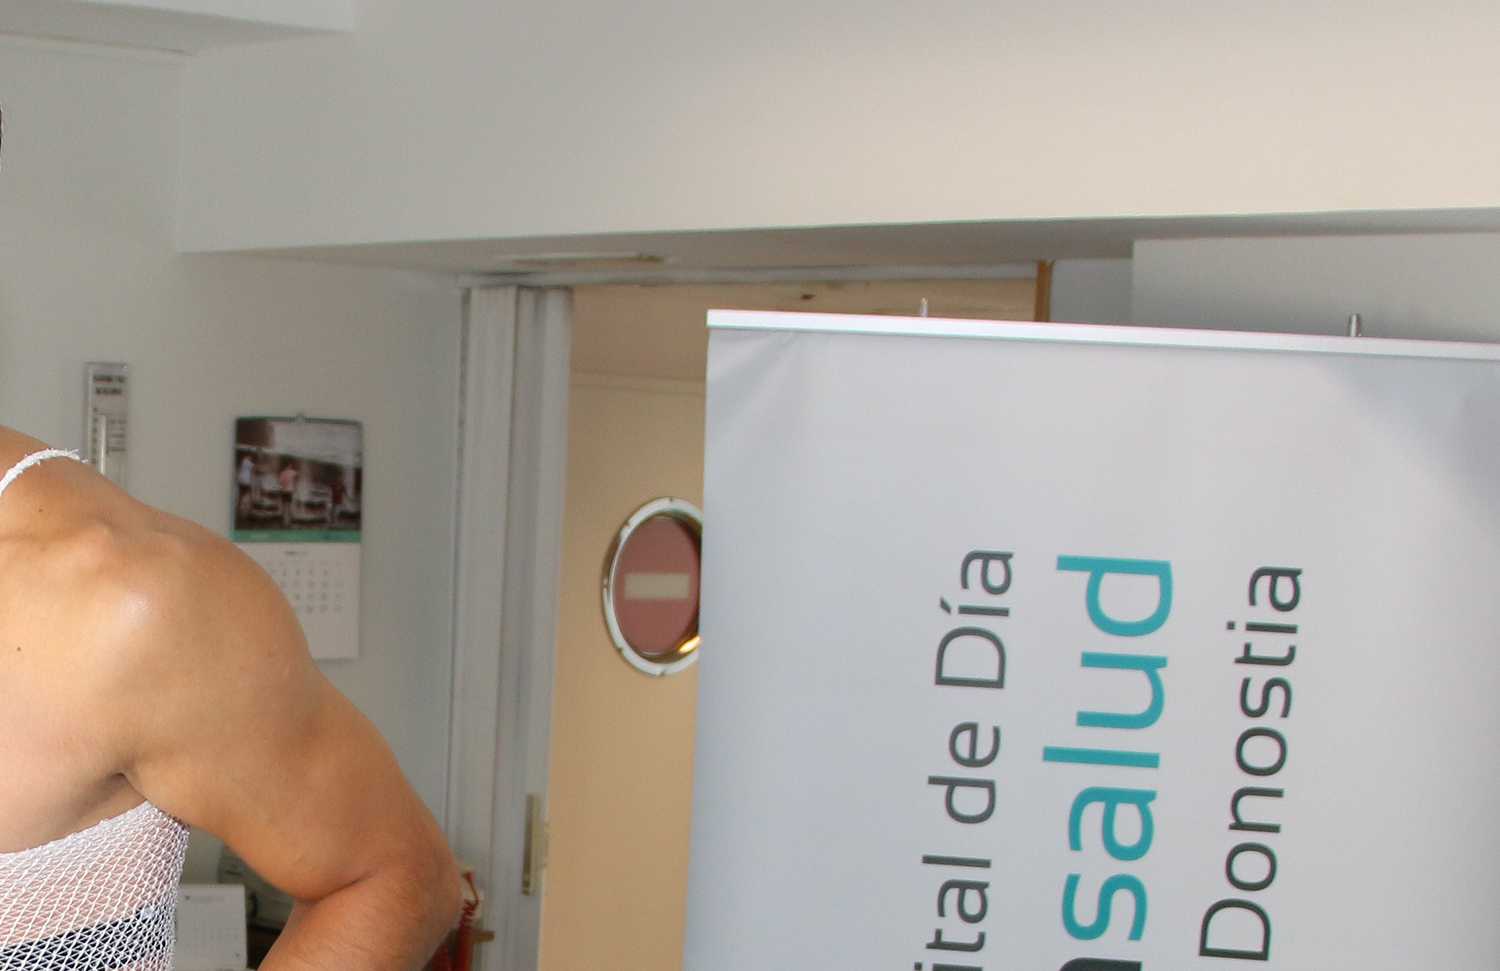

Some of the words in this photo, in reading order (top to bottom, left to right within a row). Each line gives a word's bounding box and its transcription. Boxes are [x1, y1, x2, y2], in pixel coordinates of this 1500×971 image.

[934, 549, 1014, 689] Día
[928, 721, 1001, 824] de
[1199, 566, 1303, 961] Donostia
